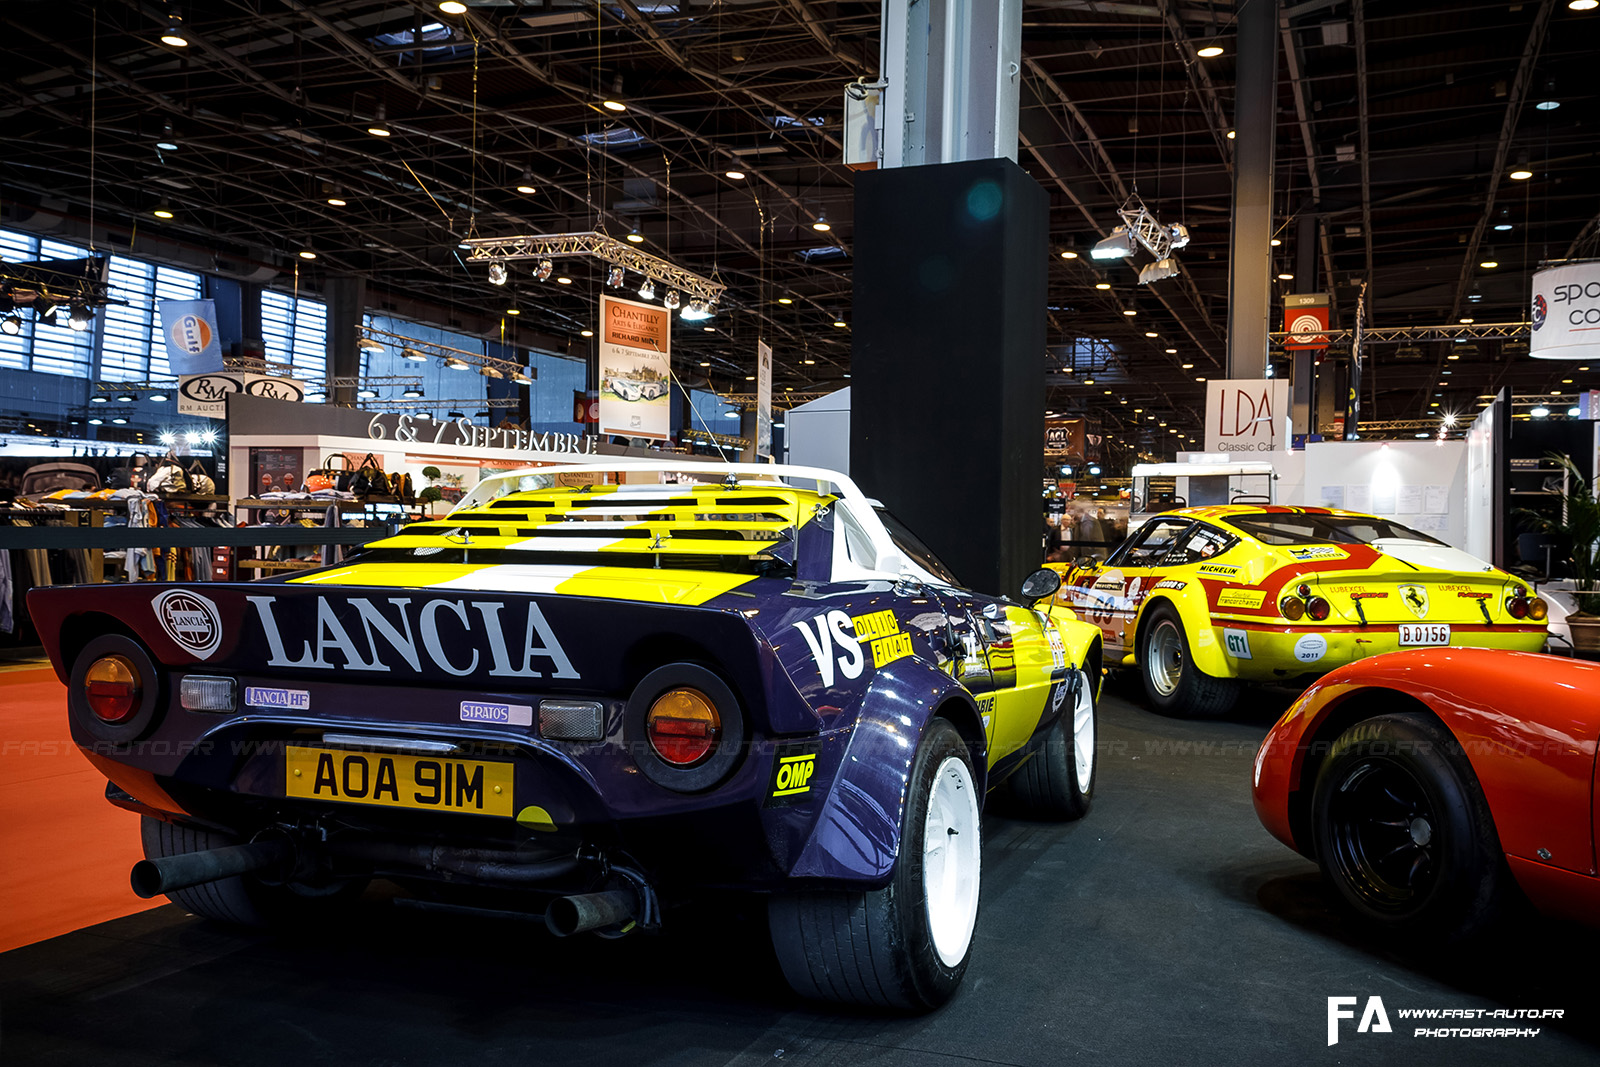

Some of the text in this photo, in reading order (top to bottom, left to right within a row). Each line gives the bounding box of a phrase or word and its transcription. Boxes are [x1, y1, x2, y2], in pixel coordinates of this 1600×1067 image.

[612, 306, 660, 324] CHANTILLY
[184, 316, 200, 353] Gulf
[612, 332, 640, 342] RICHARD
[193, 379, 228, 401] RM
[1219, 388, 1275, 437] LDA
[367, 412, 387, 440] 6
[394, 413, 421, 443] &
[432, 416, 449, 444] 7
[455, 417, 599, 455] SEPTEMBRE
[1217, 441, 1277, 452] Classic Car
[1199, 565, 1238, 575] MICHELIN
[1438, 584, 1473, 592] LUBEXCEL
[173, 615, 208, 628] LANCIA
[855, 613, 897, 637] OLIO
[245, 595, 581, 680] LANCIA
[1227, 634, 1247, 654] GT1
[1403, 626, 1447, 642] B.0156
[792, 609, 864, 688] VS
[873, 636, 910, 663] FIAT
[250, 689, 309, 706] LANCIA HF
[462, 704, 509, 720] STRATOS
[313, 753, 485, 810] AOA 91M
[776, 760, 815, 790] OMP
